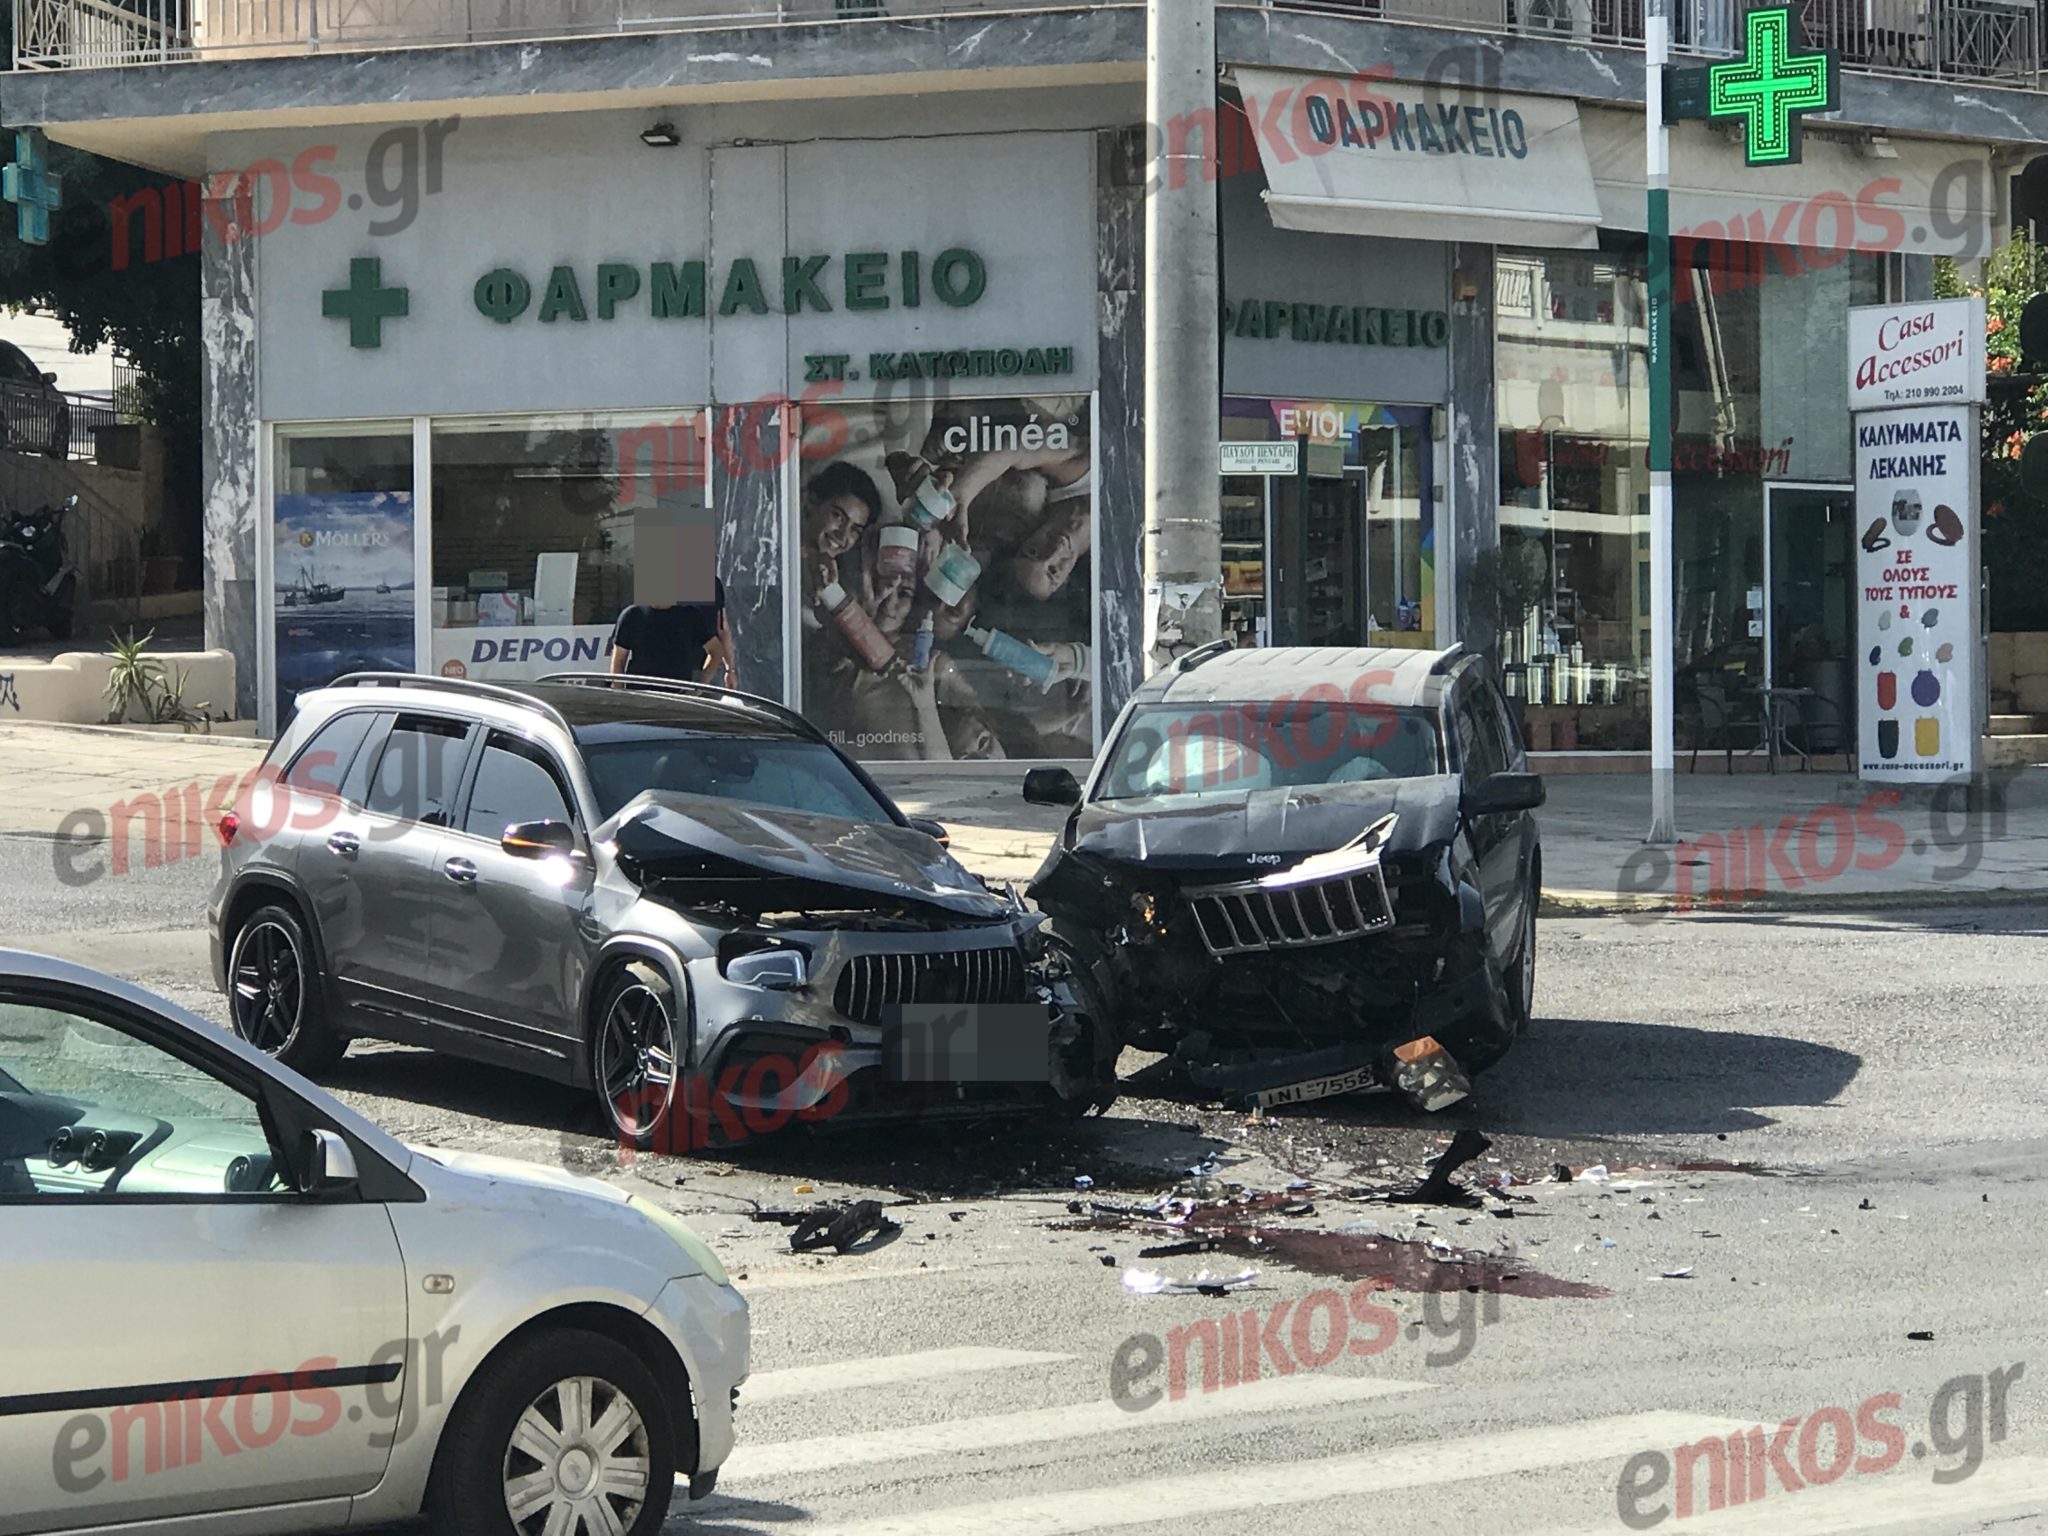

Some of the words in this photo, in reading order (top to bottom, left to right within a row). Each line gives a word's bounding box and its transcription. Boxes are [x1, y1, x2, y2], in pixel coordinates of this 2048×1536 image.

[1306, 95, 1528, 160] ΦΑΡΜΑΚΕΙΟ
[473, 247, 987, 324] ΦΑΡΜΑΚΕΙΟ
[1878, 312, 1935, 352] Casa
[804, 353, 860, 383] ΣΤ.
[869, 345, 1073, 380] ΚΑΤΩΠΟΔΗ
[1884, 389, 1904, 402] Τηλ:
[1905, 388, 1922, 399] 210
[1923, 387, 1940, 398] 990
[1942, 385, 1964, 397] 2004
[1280, 408, 1353, 439] EVIOL
[1859, 420, 1962, 448] ΚΑΛΥΜΜΑΤΑ
[1869, 454, 1947, 480] ΛΕΚΑΝΗΣ
[1896, 550, 1912, 564] ΣΕ
[1882, 567, 1930, 582] ΟΛΟΥΣ
[1865, 587, 1893, 601] ΤΟΥΣ
[1898, 584, 1958, 600] ΤΥΠΟΥΣ
[1899, 605, 1910, 619] &
[471, 637, 601, 662] DEPON
[1246, 852, 1281, 867] Jeep
